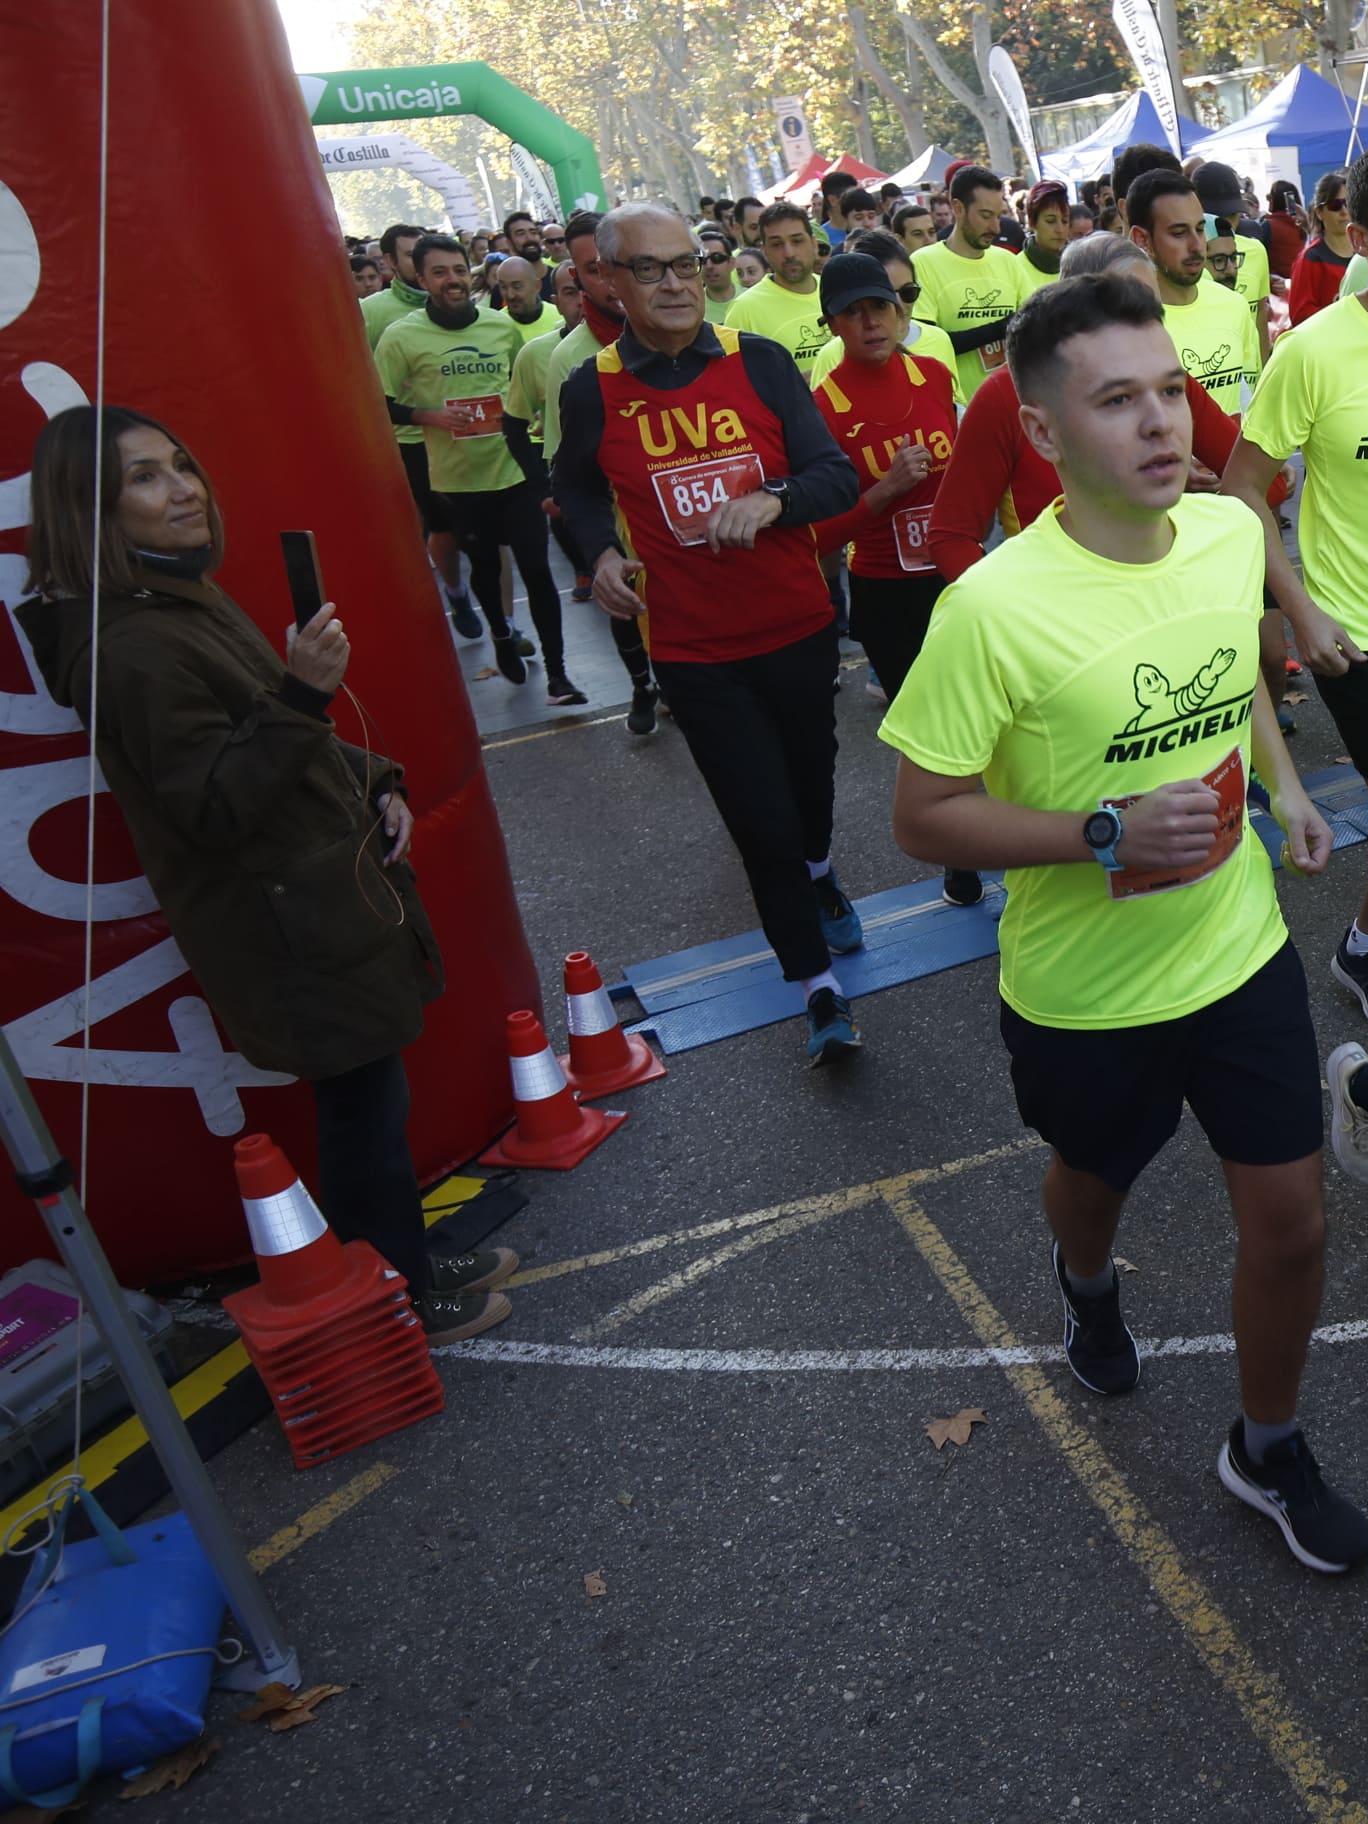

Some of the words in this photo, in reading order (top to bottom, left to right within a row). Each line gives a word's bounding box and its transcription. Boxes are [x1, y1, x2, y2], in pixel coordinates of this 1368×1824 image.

[337, 80, 462, 114] Unicaja
[333, 144, 391, 164] Castilla
[440, 360, 502, 376] elecnor
[637, 402, 748, 457] UVa
[647, 454, 699, 472] Universidad
[700, 453, 711, 462] de
[711, 443, 753, 460] Valladolid
[672, 477, 730, 517] 854
